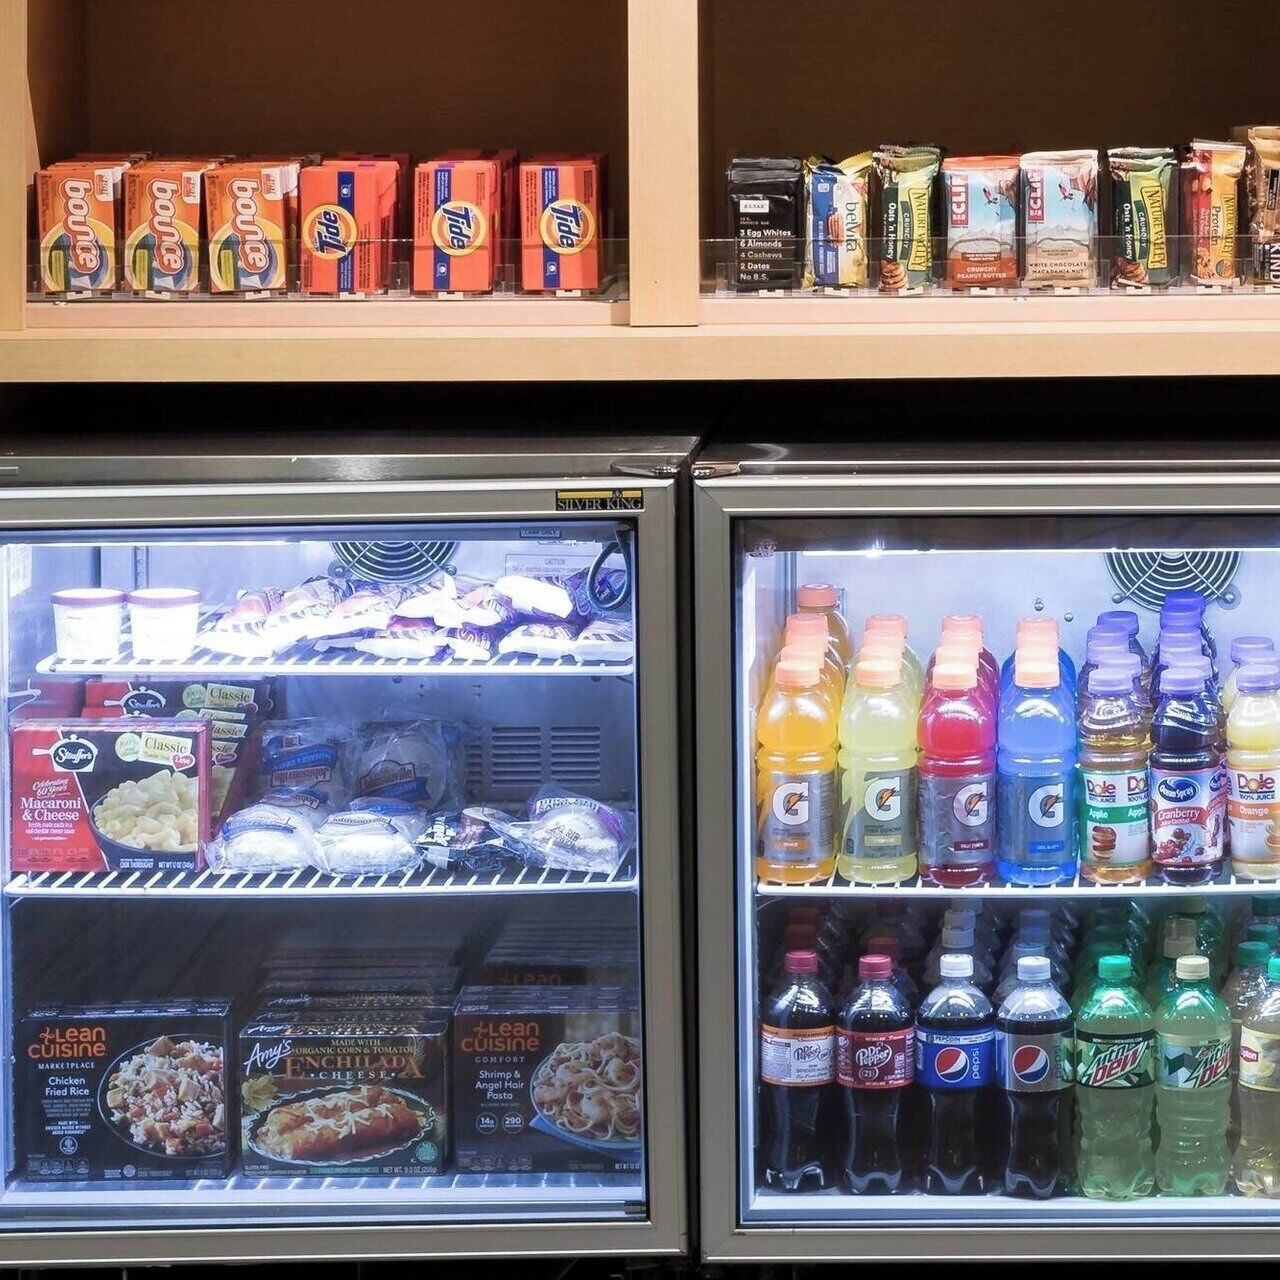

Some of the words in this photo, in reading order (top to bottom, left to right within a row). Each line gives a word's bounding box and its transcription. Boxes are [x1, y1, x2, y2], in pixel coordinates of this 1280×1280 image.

[61, 178, 100, 272] bounce
[147, 178, 186, 273] bounce
[227, 178, 269, 272] bounce
[314, 208, 349, 254] Tide
[440, 204, 473, 251] Tide
[549, 202, 584, 250] Tide
[846, 200, 860, 254] belvita
[1211, 206, 1222, 246] Protein
[740, 229, 746, 237] 3
[747, 229, 762, 239] Egg
[763, 228, 791, 237] Whites
[740, 240, 746, 248] 6
[747, 240, 782, 248] Almonds
[747, 251, 782, 259] Cashews
[740, 262, 746, 270] 2
[747, 262, 770, 270] Dates
[740, 272, 752, 280] No
[557, 499, 603, 510] SILVER
[606, 498, 642, 510] KING
[210, 686, 251, 703] Classic
[144, 737, 188, 754] Classic
[1086, 779, 1116, 796] Dole
[1237, 773, 1275, 793] Dole
[20, 797, 81, 810] Macaroni
[771, 781, 809, 826] G
[864, 776, 901, 822] G
[952, 781, 989, 827] G
[1028, 783, 1065, 828] G
[22, 810, 32, 821] &
[32, 809, 79, 822] Cheese
[1157, 807, 1201, 821] Cranberry
[1238, 806, 1270, 818] Orange
[243, 1039, 293, 1076] Amy's
[475, 1056, 526, 1064] COMFORT
[971, 1047, 981, 1079] pepsi
[37, 1062, 96, 1070] MARKETPLACE
[283, 1055, 425, 1080] ENCHILADA
[48, 1076, 86, 1086] Chicken
[319, 1070, 386, 1080] CHEESE
[479, 1070, 512, 1081] Shrimp
[513, 1071, 521, 1079] &
[45, 1087, 70, 1097] Fried
[71, 1087, 90, 1096] Rice
[475, 1081, 503, 1092] Angel
[506, 1081, 525, 1090] Hair
[486, 1091, 513, 1100] Pasta
[504, 1116, 522, 1125] 290
